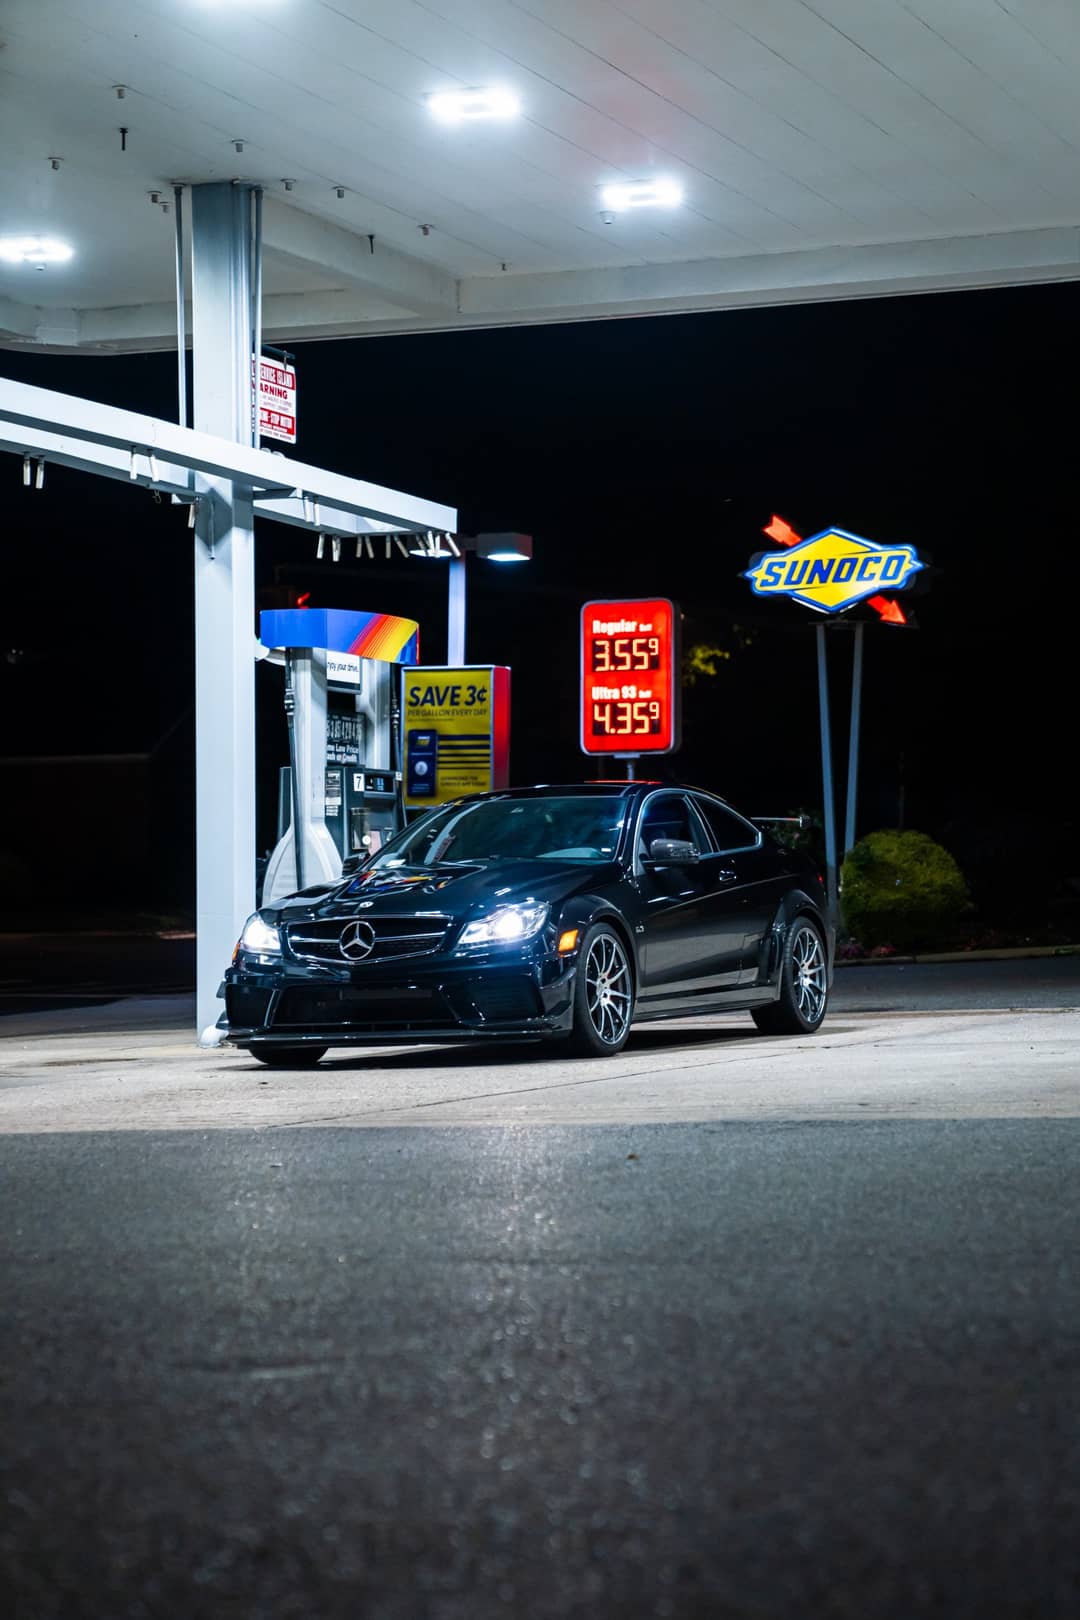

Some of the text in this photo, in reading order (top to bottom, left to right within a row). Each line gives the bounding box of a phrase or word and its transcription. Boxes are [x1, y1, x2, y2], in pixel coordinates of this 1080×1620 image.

[260, 383, 288, 399] ARNING
[759, 555, 907, 587] SUNOCO
[592, 619, 637, 636] Regular
[408, 684, 488, 707] SAVE 3¢
[591, 685, 620, 700] Ultra
[621, 685, 637, 700] 93
[408, 708, 487, 717] PER GALLON EVERY DAY
[355, 775, 362, 790] 7
